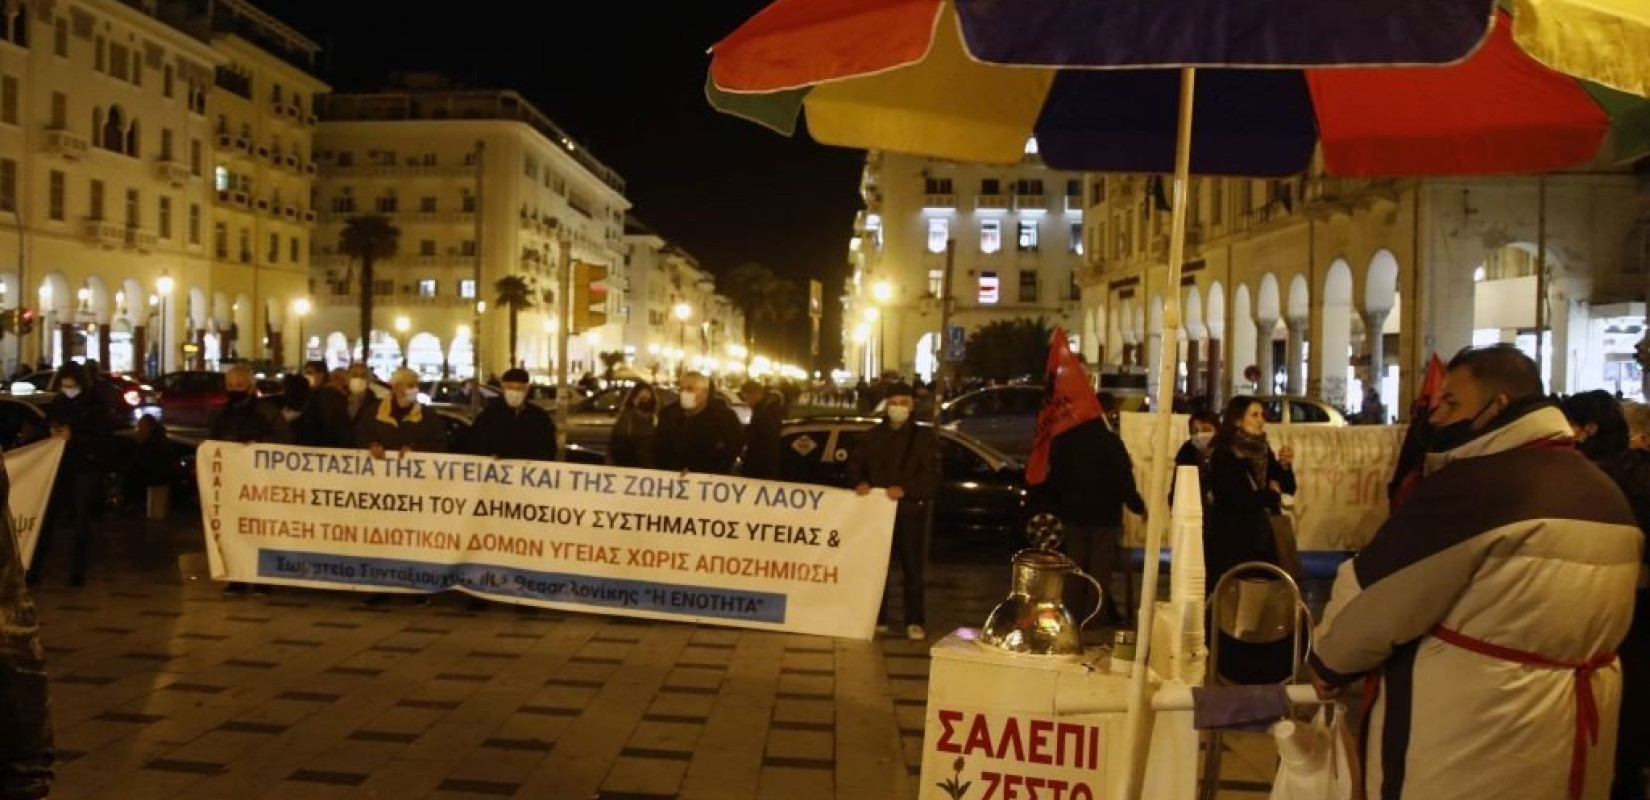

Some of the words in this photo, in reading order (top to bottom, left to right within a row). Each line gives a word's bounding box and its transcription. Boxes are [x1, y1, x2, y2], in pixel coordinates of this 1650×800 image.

[253, 449, 375, 477] ΠΡΟΣΤΑΣΙΑ
[385, 457, 426, 480] ΤΗΣ
[433, 460, 514, 485] ΥΓΕΙΑΣ
[521, 466, 560, 489] ΚΑΙ
[569, 470, 617, 494] ΤΗΣ
[623, 475, 690, 499] ΖΩΗΣ
[697, 481, 748, 504] ΤΟΥ
[754, 486, 826, 511] ΛΑΟΥ
[238, 484, 305, 505] ΑΜΕΣΗ
[310, 488, 423, 513] ΣΤΕΛΕΧΩΣΗ
[430, 496, 468, 516] ΤΟΥ
[472, 499, 586, 526] ΔΗΜΟΣΙΟΥ
[592, 510, 740, 539] ΣΥΣΤΗΜΑΤΟΣ
[746, 523, 822, 546] ΥΓΕΙΑΣ
[827, 529, 841, 548] &
[237, 517, 315, 540] ΕΠΙΤΑΞΗ
[321, 523, 358, 543] ΤΩΝ
[363, 525, 461, 551] ΙΔΙΩΤΙΚΩΝ
[466, 533, 544, 557] ΔΟΜΩΝ
[550, 540, 621, 565] ΥΓΕΙΑΣ
[626, 547, 690, 571] ΧΩΡΙΣ
[695, 554, 839, 584] ΑΠΟΖΗΜΙΩΣΗ
[936, 709, 1100, 770] ΣΑΛΕΠΙ
